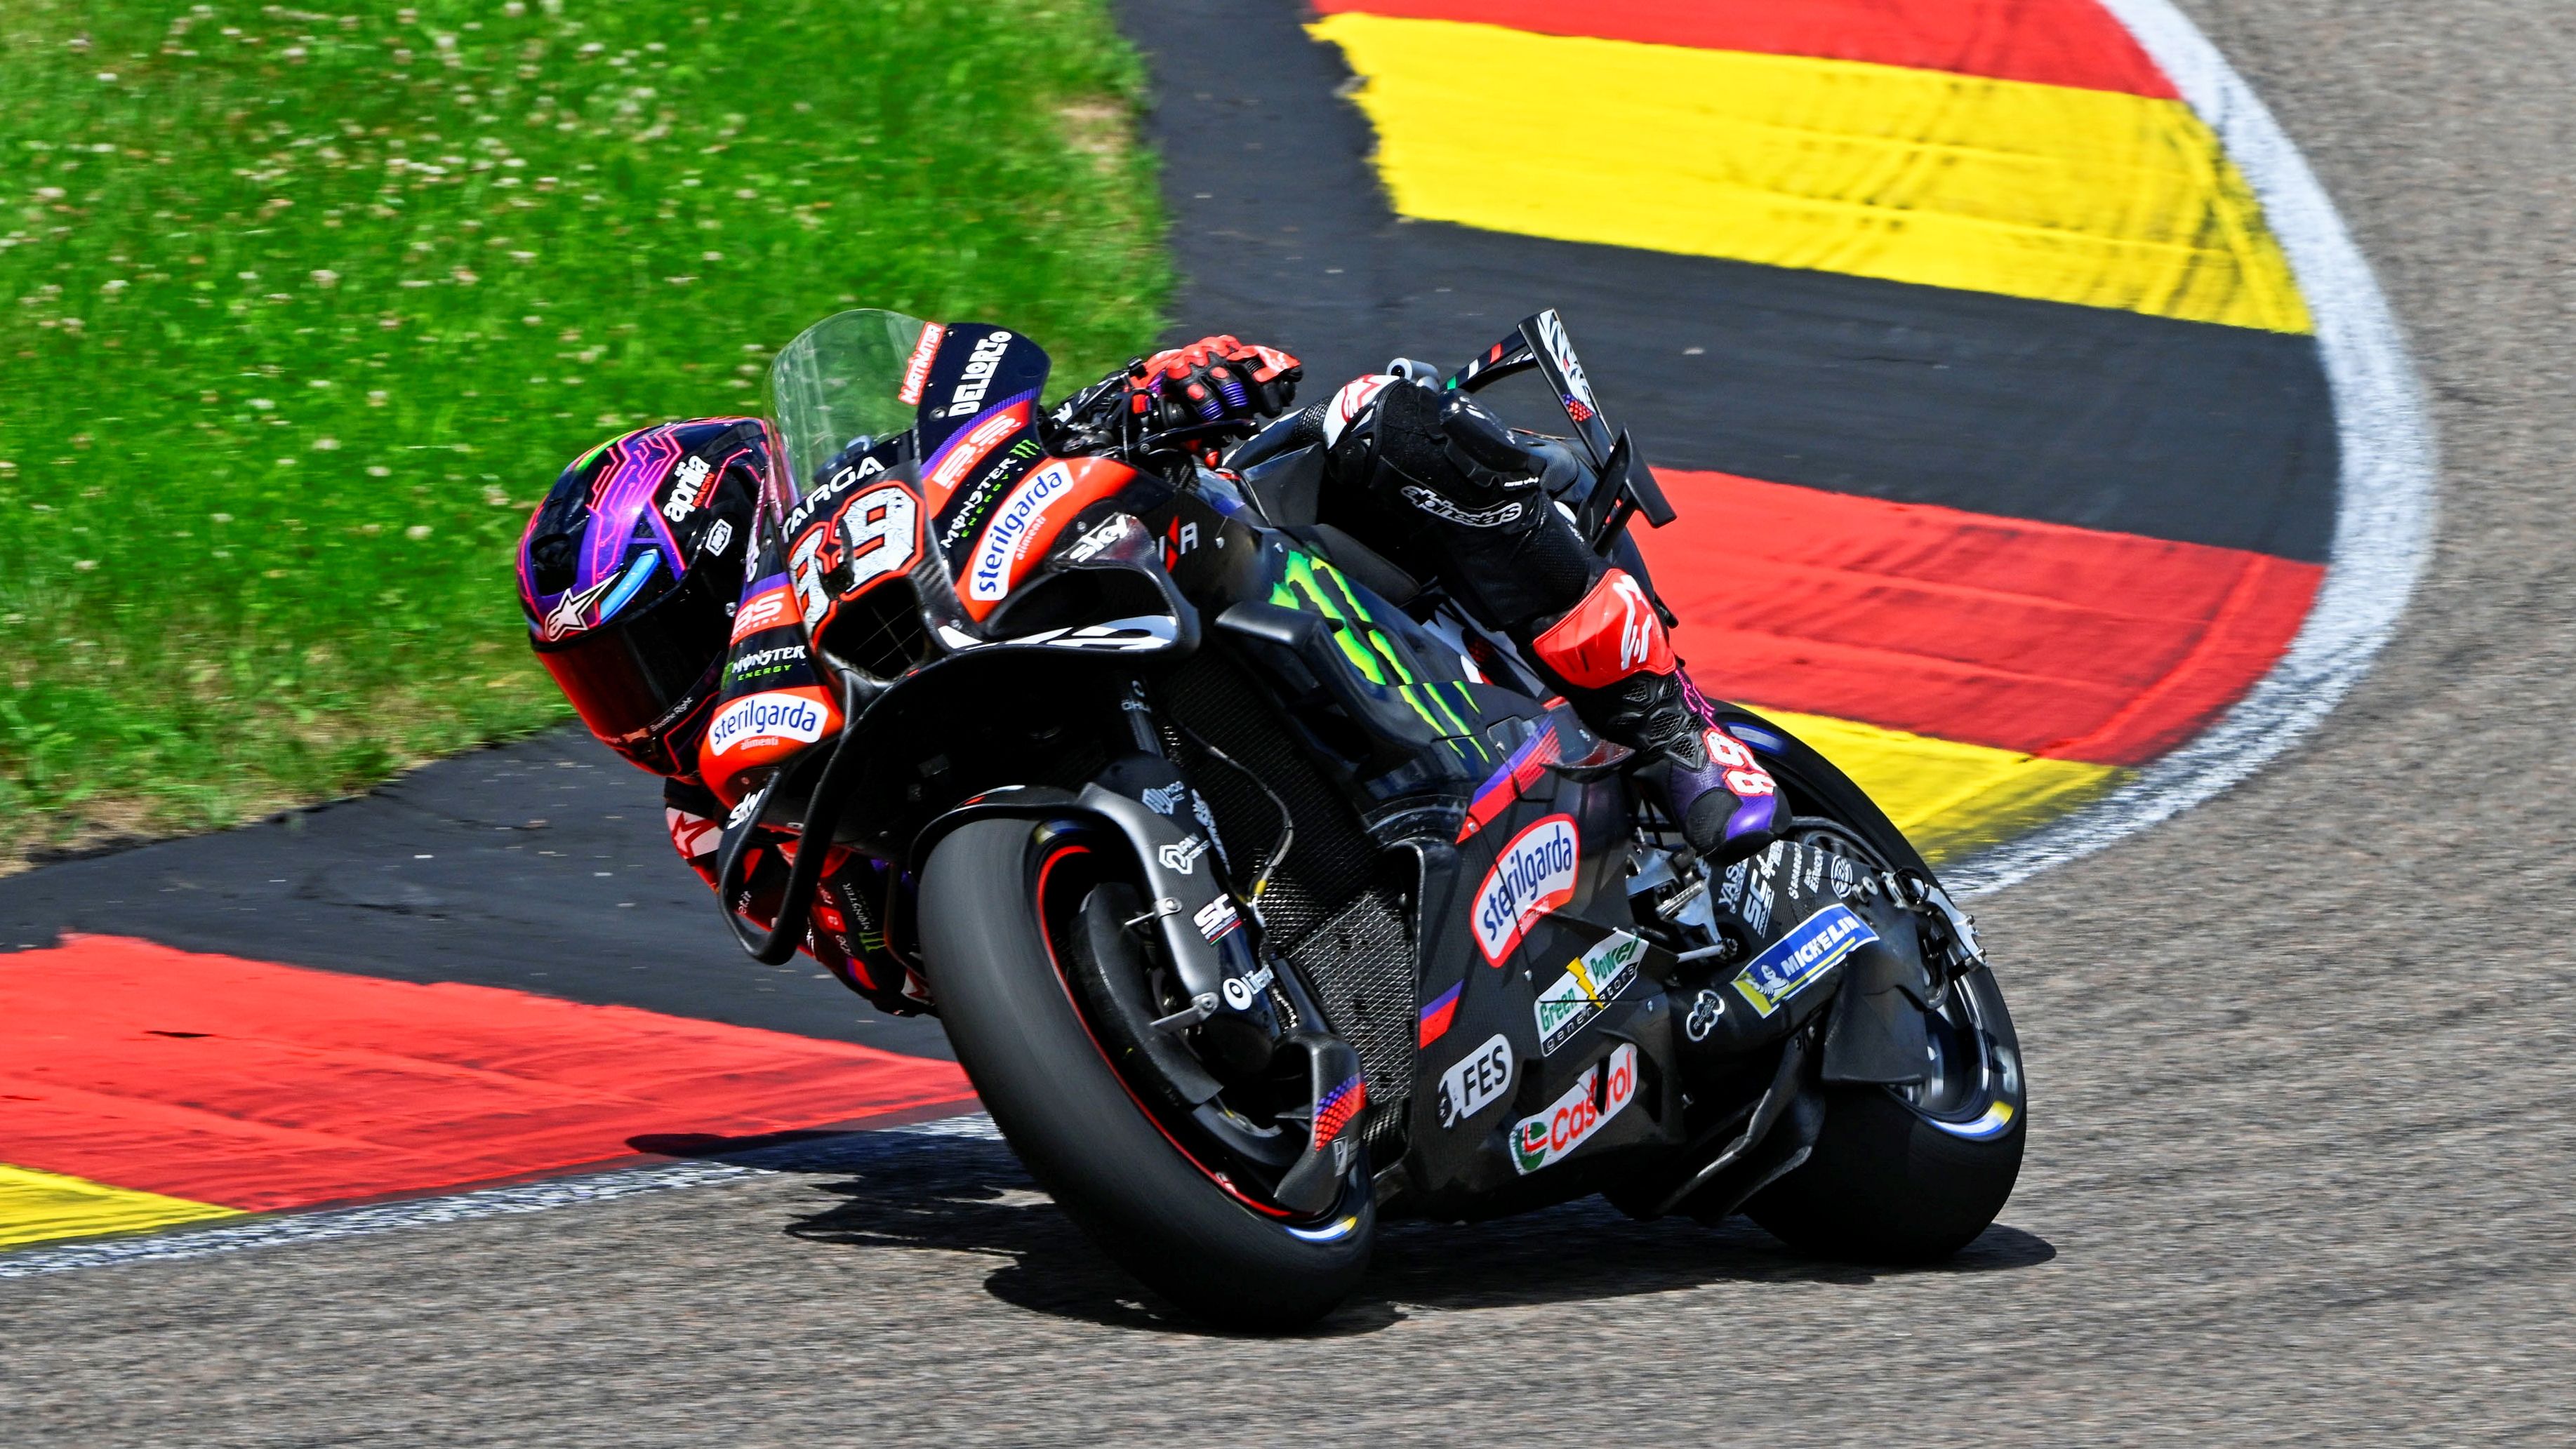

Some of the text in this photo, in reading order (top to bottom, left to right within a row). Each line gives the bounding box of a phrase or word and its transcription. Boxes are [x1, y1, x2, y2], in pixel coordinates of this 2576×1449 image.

[931, 414, 1016, 488] BS
[663, 455, 711, 522] aprilia
[781, 455, 885, 543] TARGA
[940, 458, 1018, 549] MONSTER
[977, 472, 1063, 593] sterilgarda
[1015, 514, 1047, 561] alimenti
[1069, 514, 1129, 563] sky
[731, 645, 806, 674] MONSTER
[737, 664, 792, 681] ENERGY
[714, 700, 816, 745] sterilgarda
[740, 736, 779, 751] alimenti
[1193, 893, 1236, 935] SC
[1483, 824, 1572, 942] sterilgarda
[1743, 868, 1767, 930] SC
[1780, 915, 1861, 977] MICHELIN
[1539, 987, 1577, 1033] Green
[1462, 1044, 1507, 1108] FES
